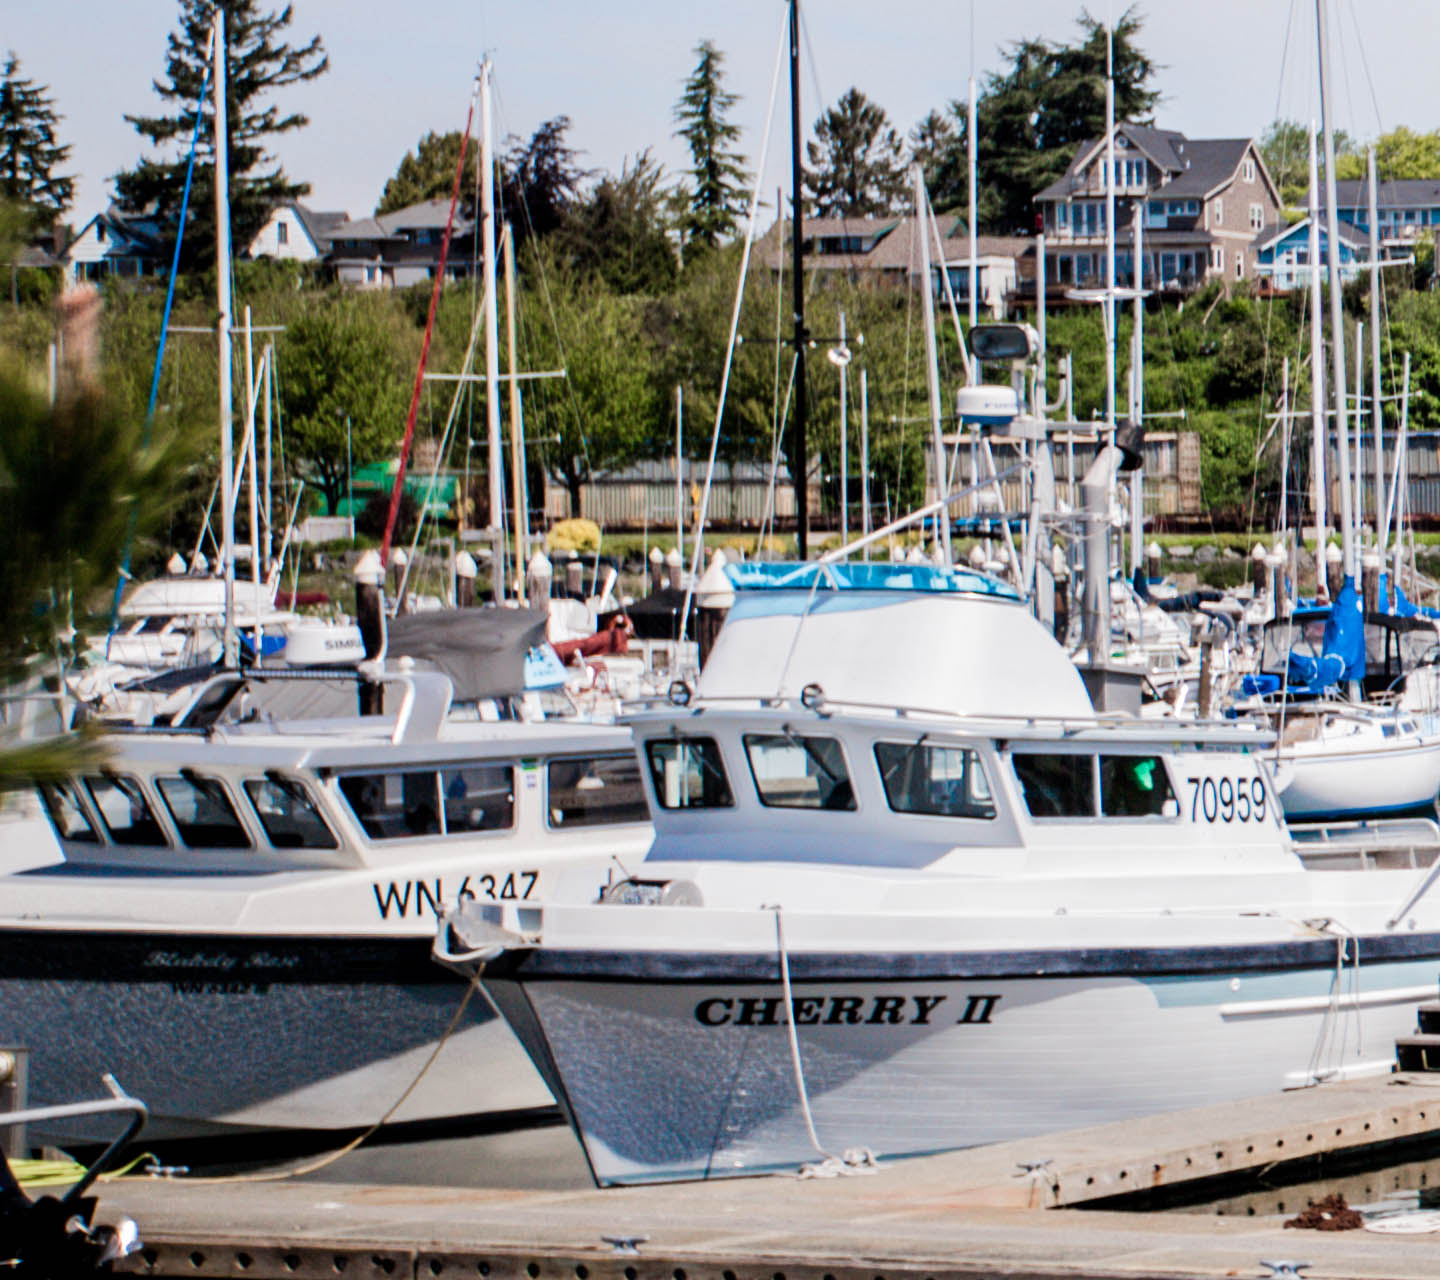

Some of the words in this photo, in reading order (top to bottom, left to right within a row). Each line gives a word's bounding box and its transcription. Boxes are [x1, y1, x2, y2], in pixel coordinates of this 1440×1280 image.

[1187, 776, 1266, 823] 70959
[372, 878, 443, 919] WN
[693, 995, 948, 1027] CHERRY
[956, 994, 1003, 1025] II
